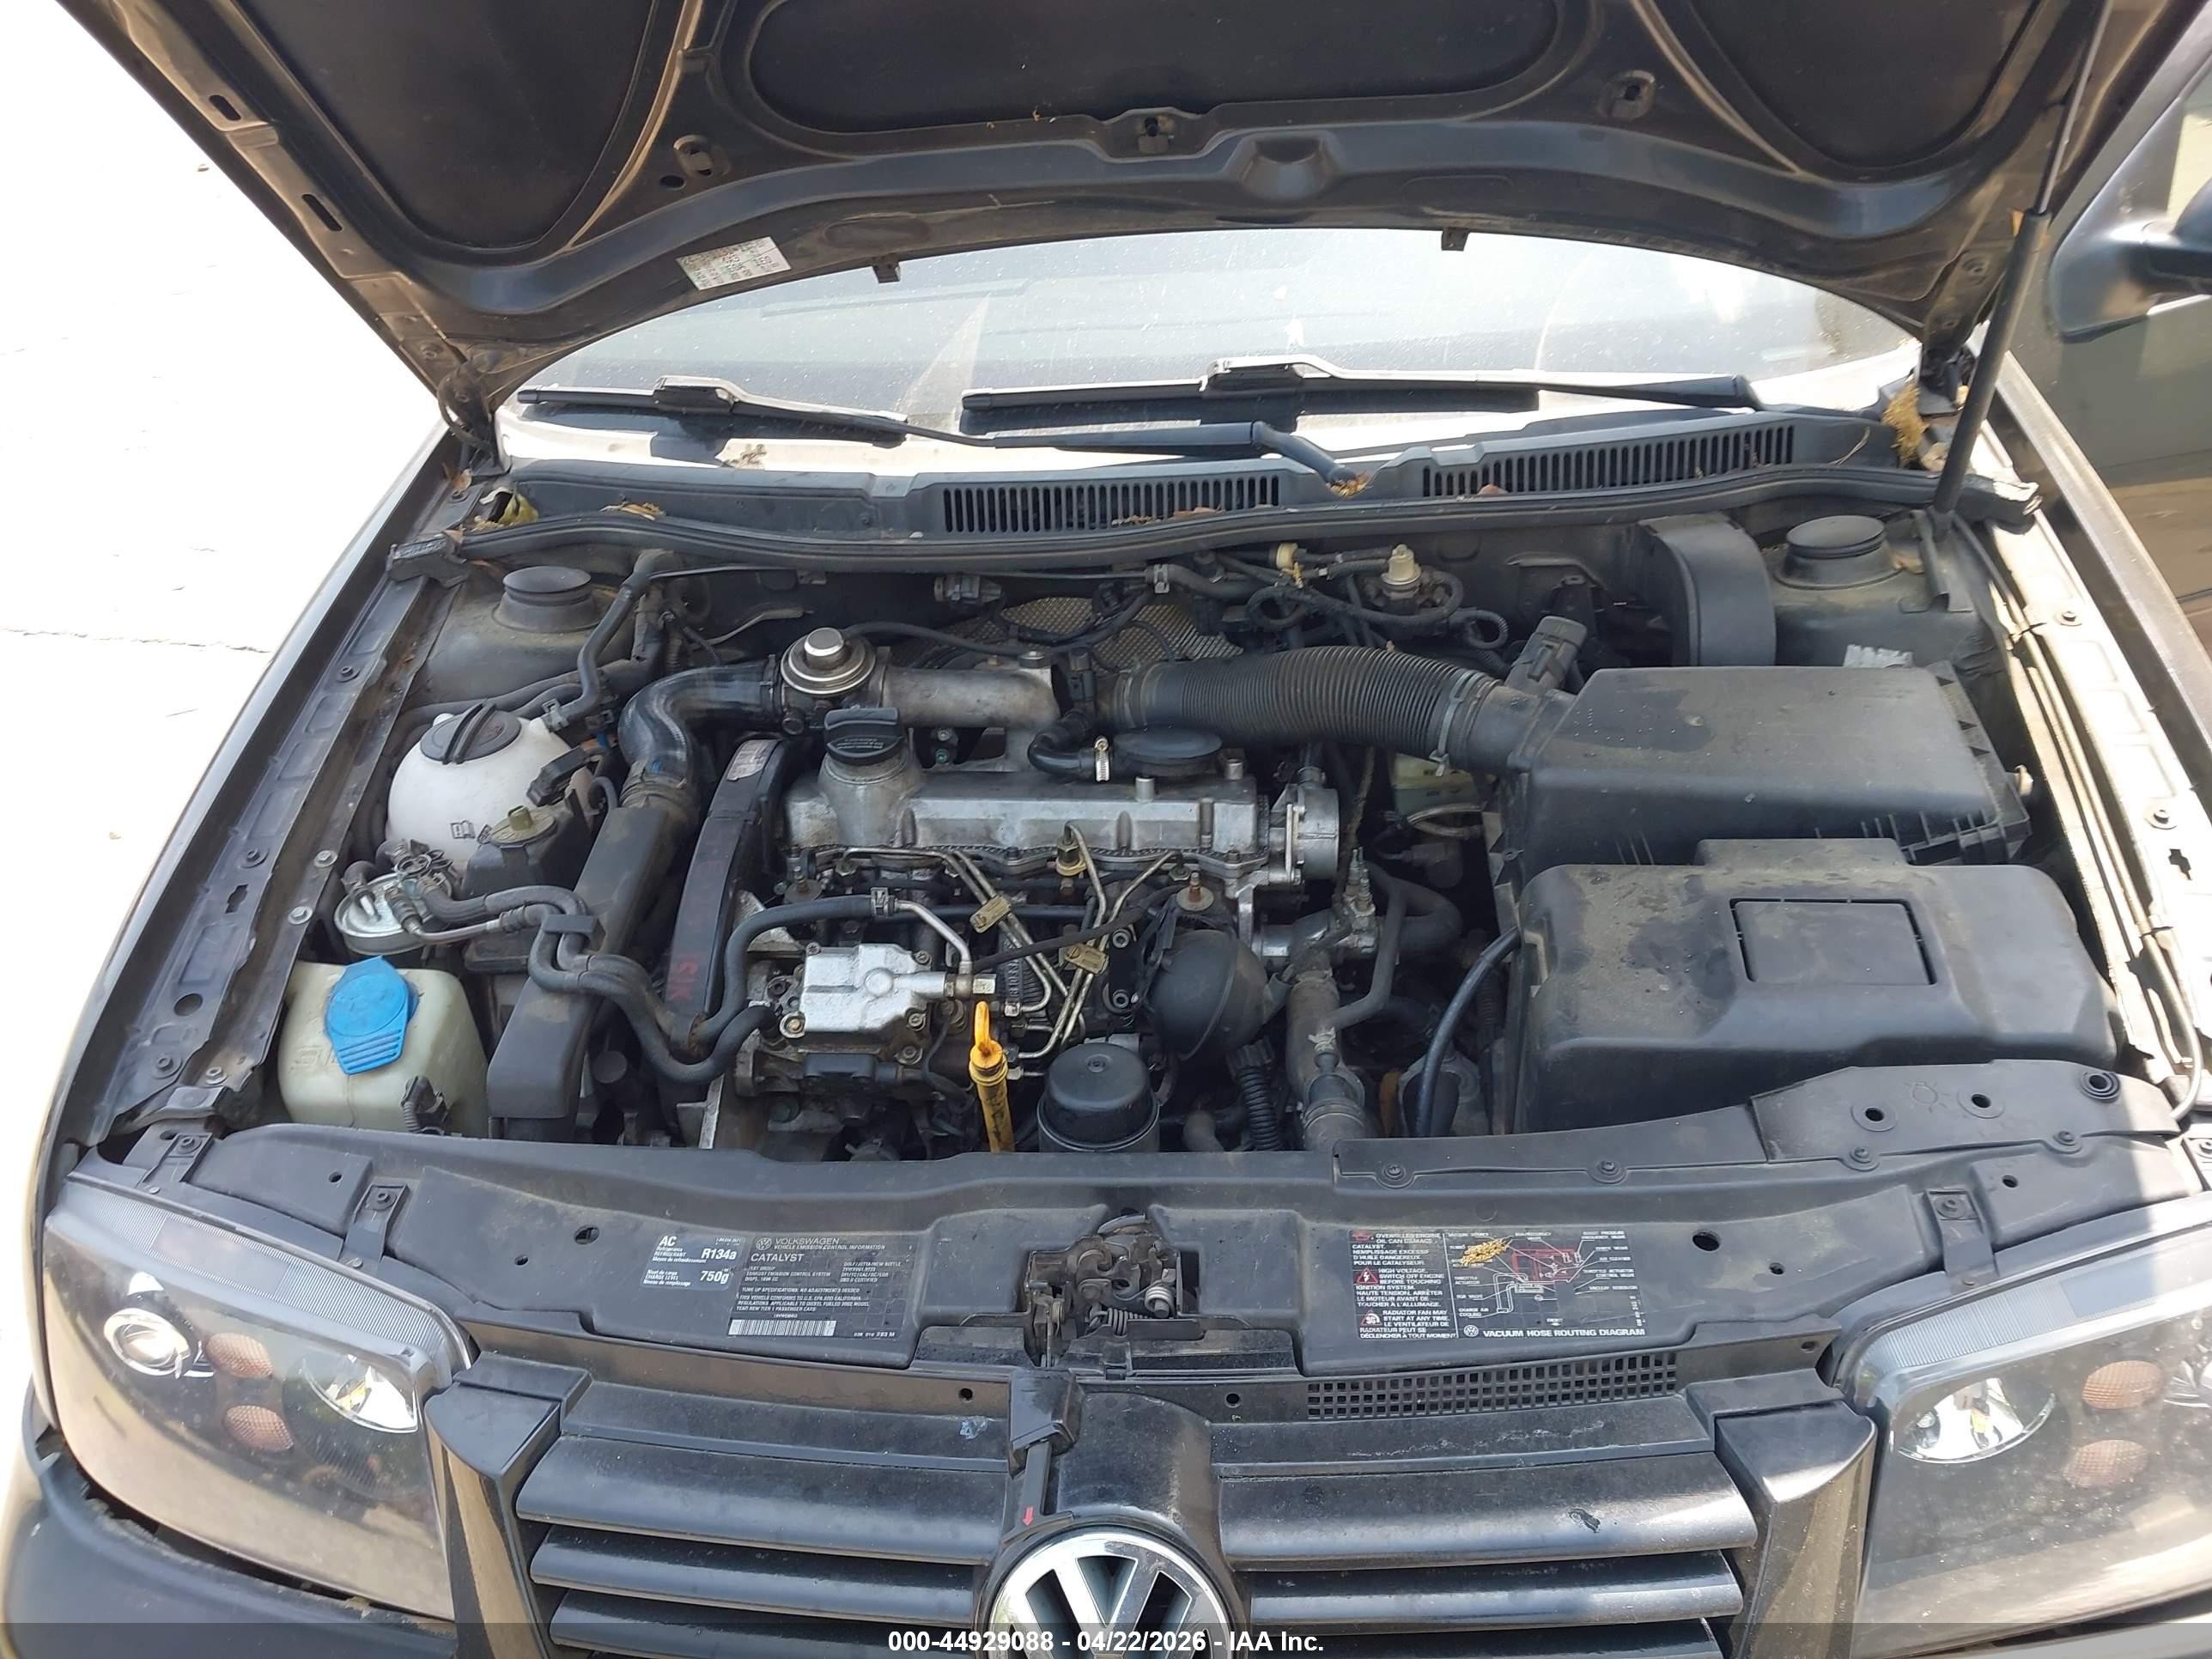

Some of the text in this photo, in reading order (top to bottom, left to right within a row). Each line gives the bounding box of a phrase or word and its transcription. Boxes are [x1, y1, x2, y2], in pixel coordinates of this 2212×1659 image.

[659, 1236, 678, 1246] AC
[701, 1248, 738, 1260] R134a
[700, 1271, 730, 1285] 750g
